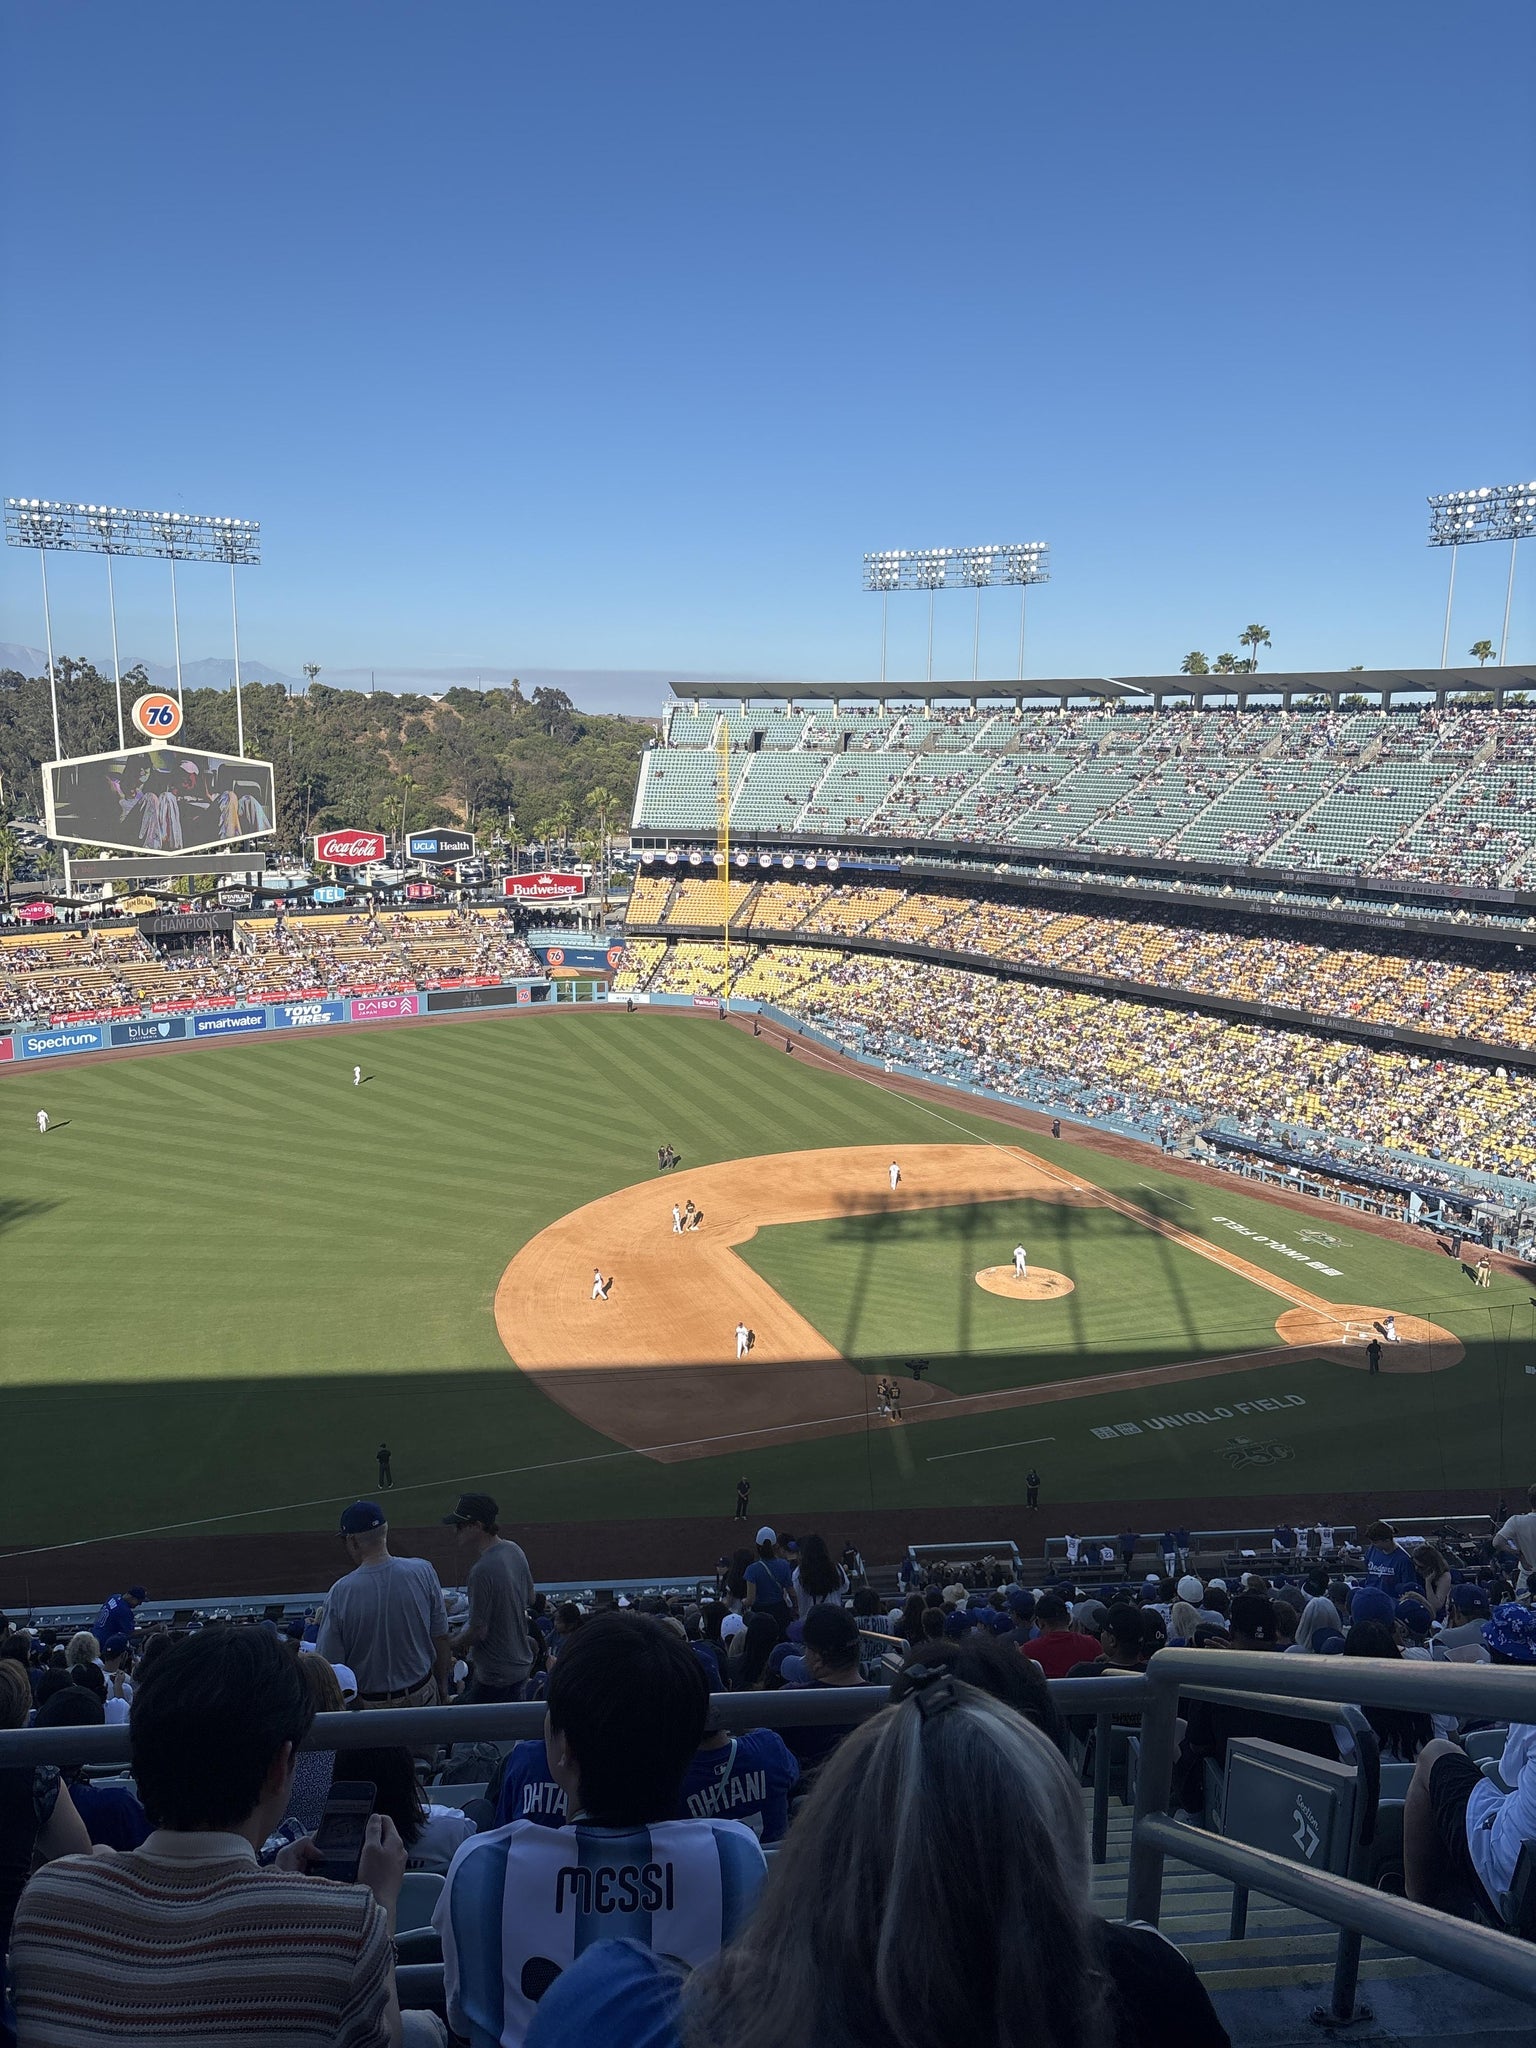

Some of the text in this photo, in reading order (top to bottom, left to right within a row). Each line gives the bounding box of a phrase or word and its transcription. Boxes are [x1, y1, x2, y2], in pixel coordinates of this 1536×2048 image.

[146, 704, 174, 727] 76
[323, 838, 378, 857] Coca-Cola
[413, 841, 469, 851] UCLA Health
[319, 890, 341, 899] TEL
[512, 884, 577, 895] Budweiser
[1411, 887, 1446, 895] AMERICA
[126, 899, 153, 910] JIM BEAM
[153, 915, 219, 932] CHAMPIONS
[1269, 905, 1290, 915] 24/25
[1365, 918, 1406, 928] CHAMPIONS
[550, 951, 561, 960] 76
[284, 1005, 322, 1016] TOYO
[358, 1000, 397, 1010] DAISO
[198, 1015, 263, 1031] smartwater
[291, 1012, 332, 1025] TIRES
[1312, 1016, 1326, 1025] LOS
[1361, 1024, 1394, 1038] DODGERS
[128, 1024, 158, 1037] blue
[28, 1034, 94, 1053] Spectrum
[1211, 1216, 1311, 1261] UNIQLO FIELD
[1142, 1394, 1307, 1430] UNIQLO FIELD
[1367, 1561, 1395, 1578] Dodgers
[523, 1783, 569, 1816] OHTA
[686, 1770, 767, 1818] OHTANI
[1296, 1794, 1319, 1831] Section
[1292, 1809, 1320, 1860] 27
[555, 1862, 674, 1914] MESSI
